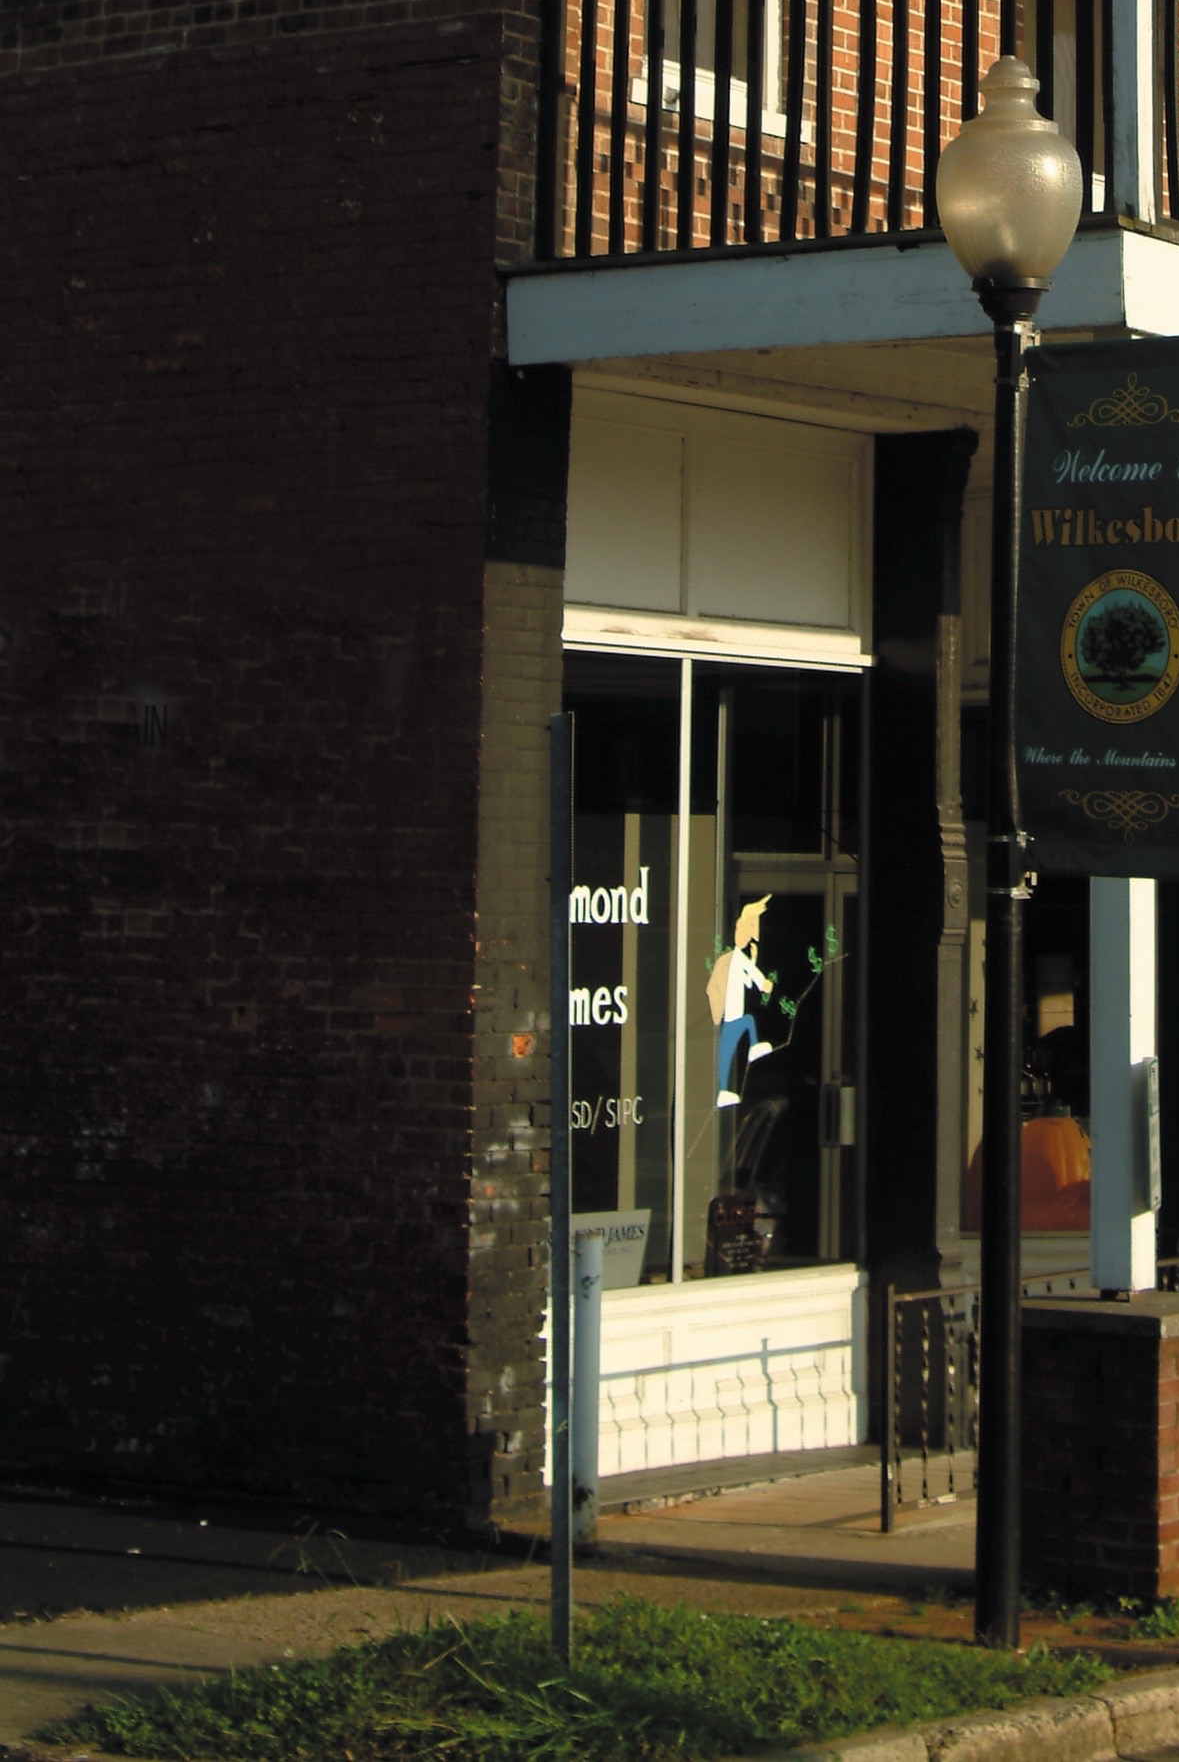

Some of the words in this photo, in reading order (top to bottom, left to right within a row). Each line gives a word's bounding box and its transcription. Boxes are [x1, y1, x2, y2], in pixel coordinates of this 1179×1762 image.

[1053, 449, 1162, 483] Welcome
[1068, 592, 1095, 628] TOWN
[1099, 579, 1111, 592] OF
[1117, 575, 1179, 629] WILKESBORO
[1071, 672, 1151, 716] INCORPORATED
[1153, 672, 1172, 700] 1847
[1023, 746, 1063, 764] Where
[1069, 748, 1091, 765] the
[1096, 748, 1177, 768] Mountains
